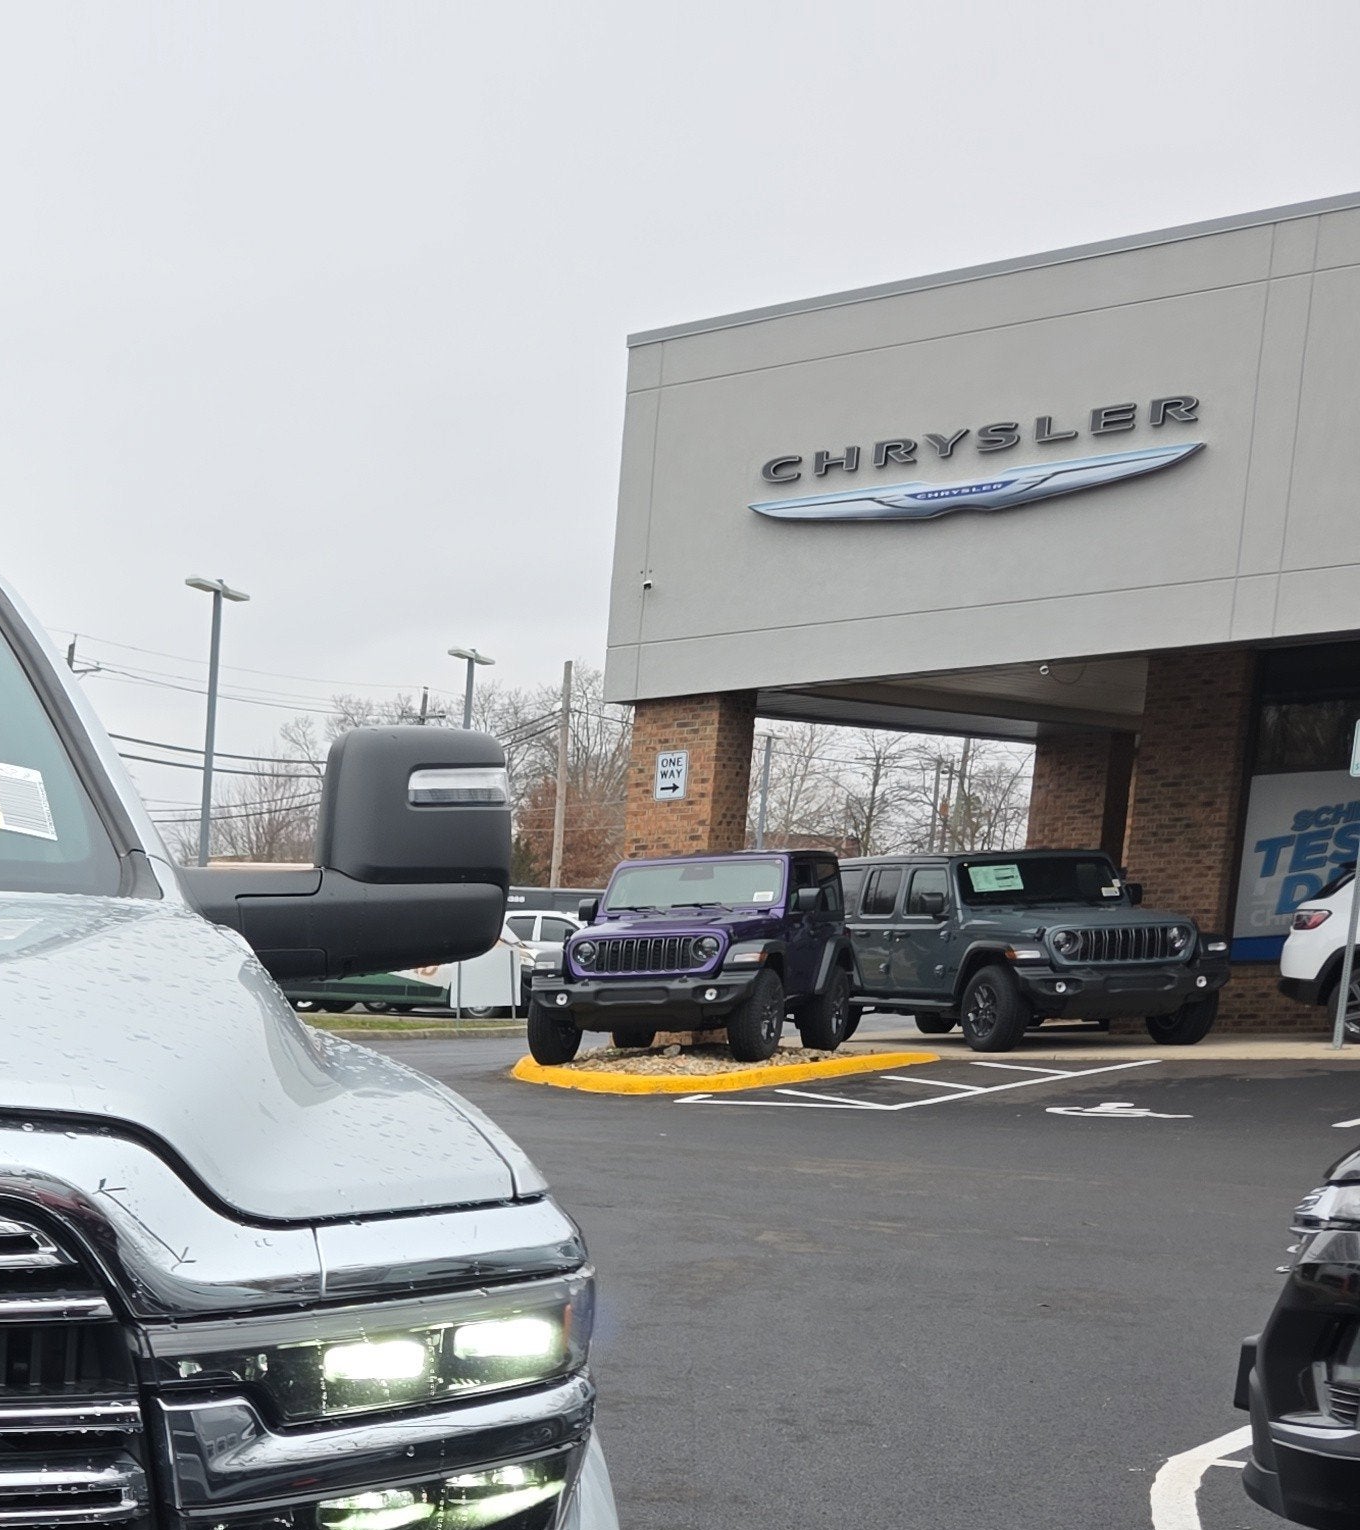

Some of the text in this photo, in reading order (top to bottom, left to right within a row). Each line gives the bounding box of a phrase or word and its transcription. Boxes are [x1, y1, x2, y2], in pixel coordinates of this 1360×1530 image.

[760, 395, 1200, 483] CHRYSLER
[661, 757, 683, 768] ONE
[660, 768, 683, 779] WAY
